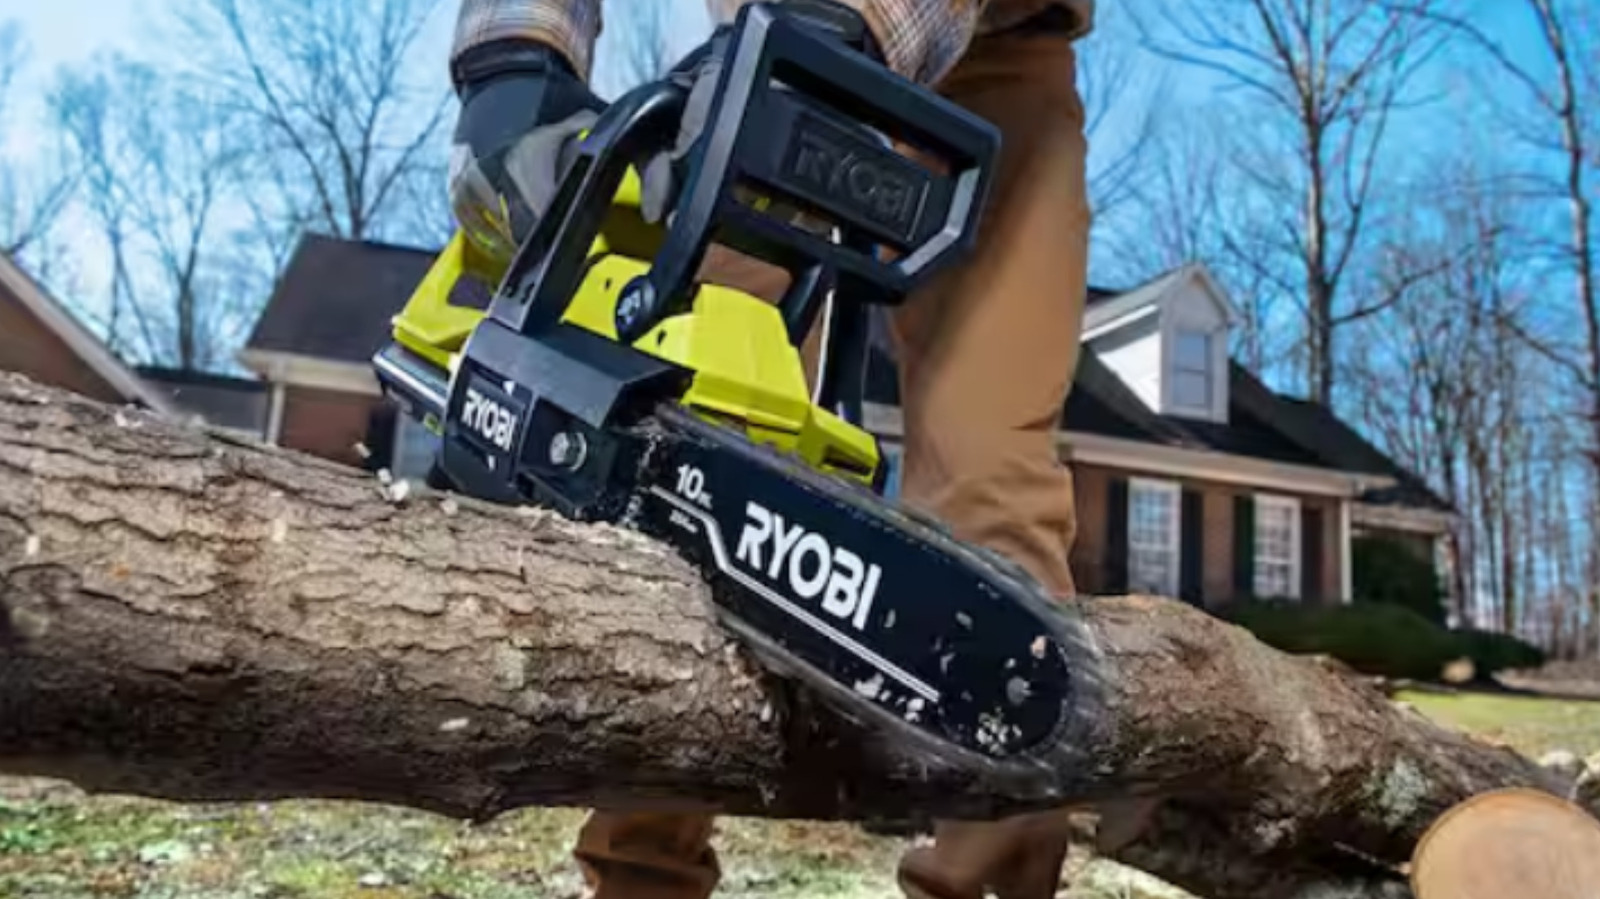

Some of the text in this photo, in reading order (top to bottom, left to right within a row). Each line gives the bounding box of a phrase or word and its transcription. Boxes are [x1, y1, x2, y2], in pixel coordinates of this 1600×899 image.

[795, 130, 914, 222] RYOBI
[461, 387, 516, 451] RYOBI
[736, 501, 882, 630] RYOBI
